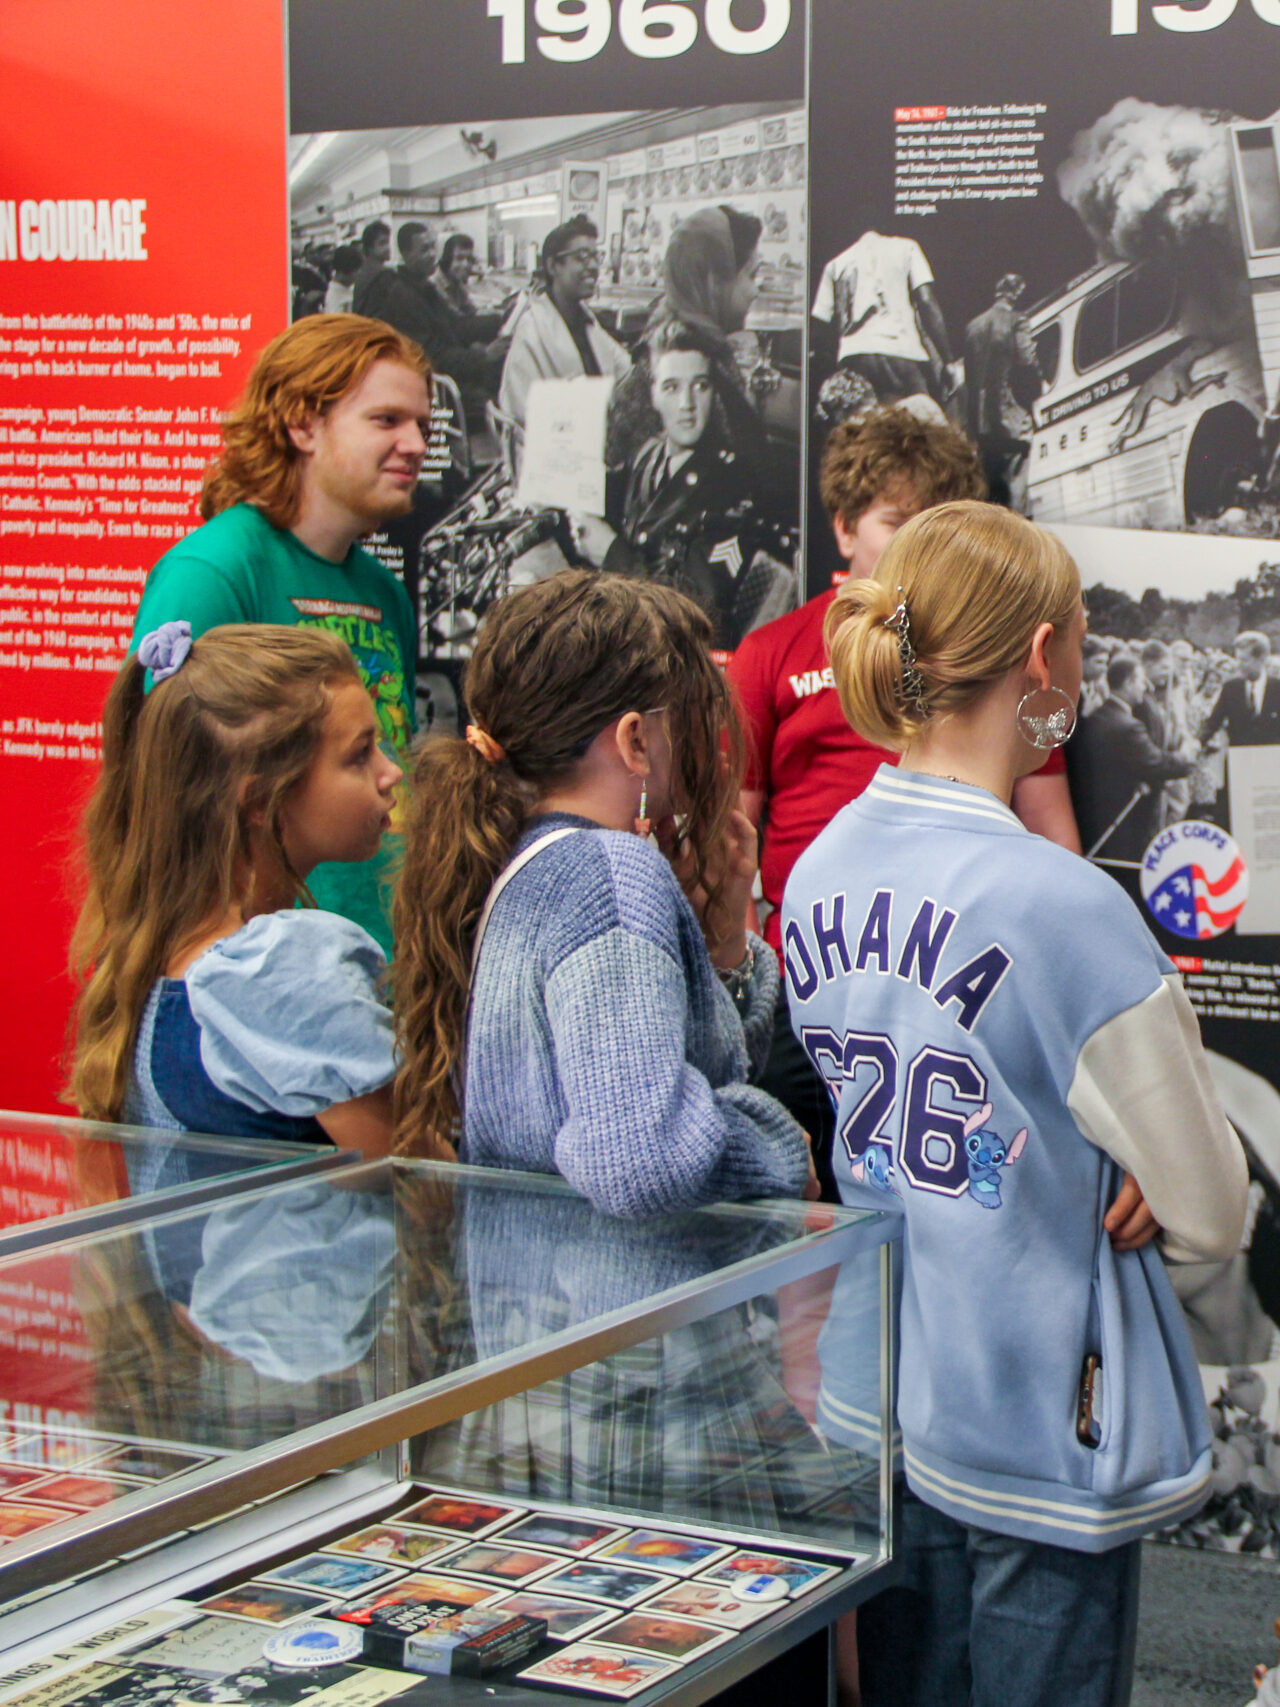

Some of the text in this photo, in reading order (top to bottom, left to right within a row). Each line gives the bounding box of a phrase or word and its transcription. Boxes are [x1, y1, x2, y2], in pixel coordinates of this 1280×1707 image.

[487, 0, 791, 63] 1960
[20, 199, 148, 261] COURAGE
[1145, 825, 1227, 872] PEACE CORPS
[785, 887, 1014, 1035] OHANA
[73, 1619, 149, 1649] WORLD
